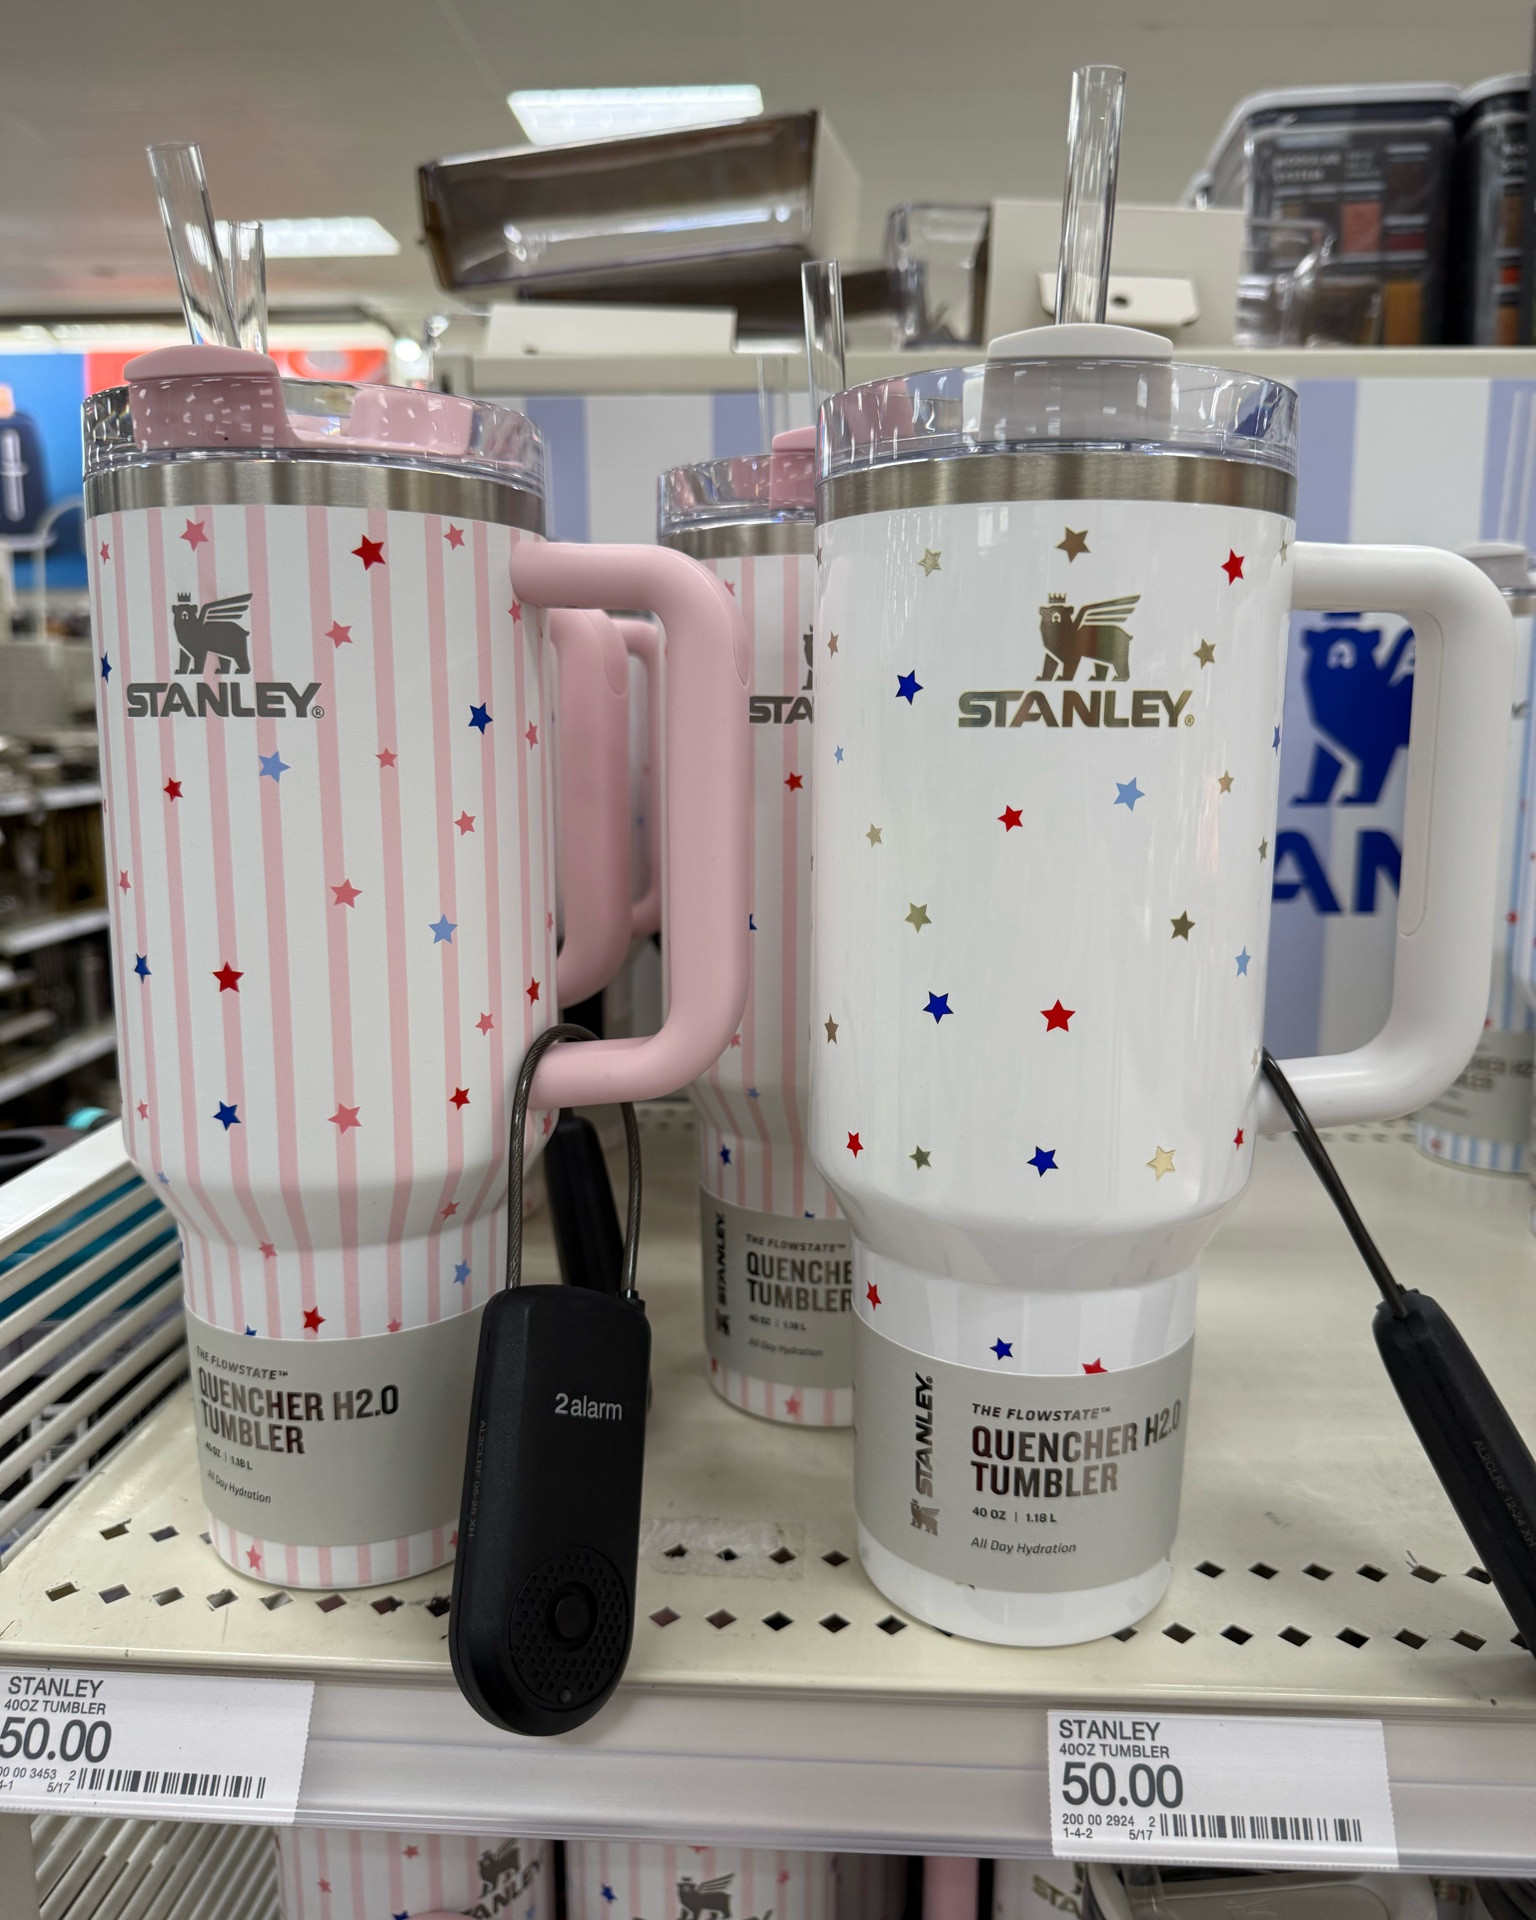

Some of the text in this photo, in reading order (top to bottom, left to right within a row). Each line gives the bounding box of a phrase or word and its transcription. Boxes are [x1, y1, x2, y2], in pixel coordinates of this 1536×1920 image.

[749, 696, 812, 725] STA
[1272, 830, 1402, 915] AN
[746, 1234, 765, 1246] THE
[747, 1252, 852, 1284] QUENCHE
[746, 1278, 852, 1312] TUMBLER
[196, 1345, 209, 1361] THE
[198, 1366, 325, 1421] QUENCHER
[554, 1392, 623, 1421] 2alarm
[971, 1403, 1001, 1418] THE
[201, 1398, 305, 1454] TUMBLER
[971, 1422, 1138, 1463] QUENCHER
[215, 1474, 228, 1491] Day
[228, 1482, 271, 1504] Hydration
[970, 1459, 1119, 1499] TUMBLER
[972, 1506, 1057, 1524] 40 OZ 1.18 L
[970, 1536, 1077, 1556] All Day Hydration
[8, 1676, 104, 1698] STANLEY
[4, 1699, 107, 1716] 40OZ TUMBLER
[0, 1716, 112, 1763] 50.00
[1058, 1719, 1161, 1741] STANLEY
[1058, 1743, 1170, 1759] 40OZ TUMBLER
[13, 1767, 27, 1779] 00
[29, 1768, 57, 1780] 3453
[68, 1770, 76, 1781] 2
[1062, 1762, 1184, 1809] 50.00
[46, 1782, 71, 1794] 5/17
[1062, 1814, 1156, 1828] 200 00 2924 2
[1063, 1828, 1154, 1841] 1-4-2 5/17
[1032, 1874, 1081, 1920] STA
